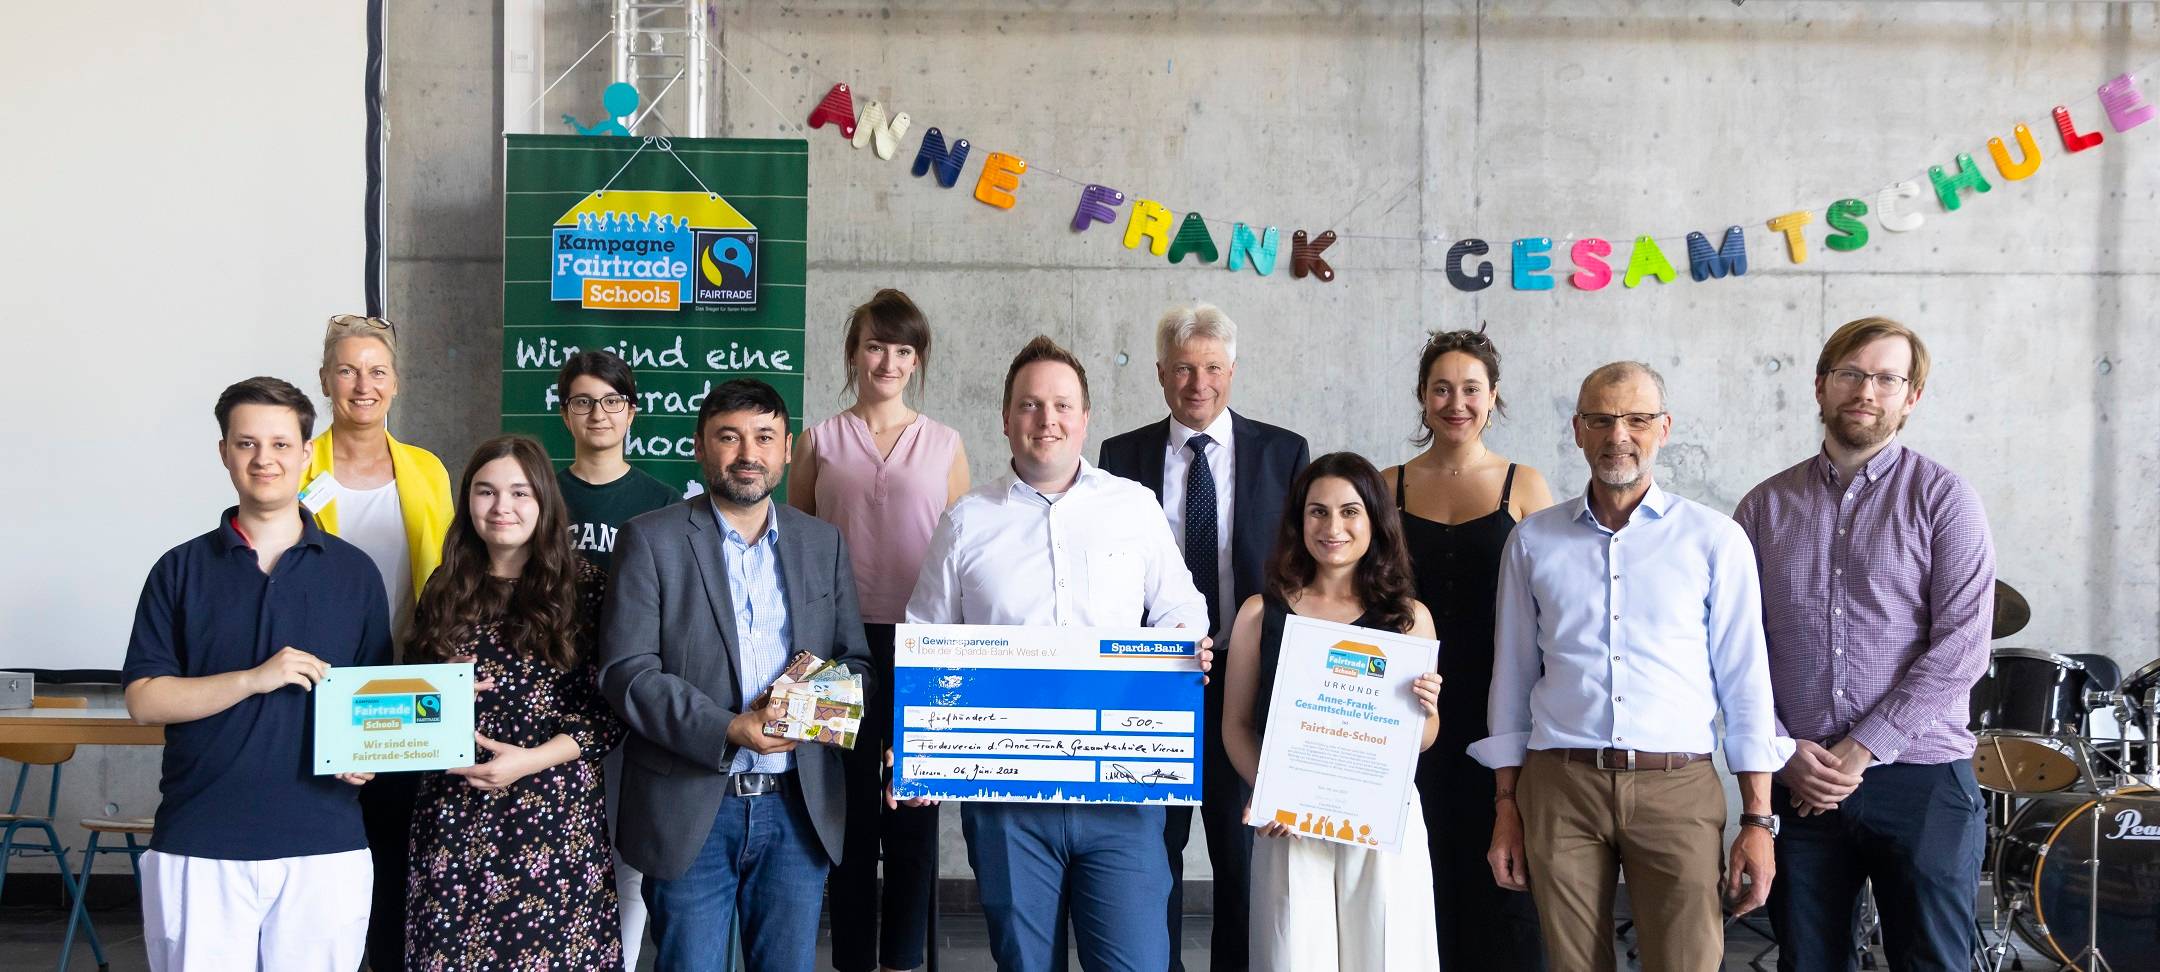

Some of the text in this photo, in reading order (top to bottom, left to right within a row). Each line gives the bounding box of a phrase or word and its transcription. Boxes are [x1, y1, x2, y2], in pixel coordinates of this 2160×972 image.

[807, 71, 2156, 292] ANNE FRANK GESAMTSCHULE
[558, 234, 676, 256] Kampagne
[557, 254, 688, 278] Fairtrade
[590, 284, 671, 304] Schools
[700, 290, 752, 299] FAIRTRADE
[516, 336, 580, 368] Wir
[706, 342, 793, 371] eine
[1016, 648, 1039, 657] West
[1111, 642, 1184, 654] Sparda-Bank
[1324, 680, 1380, 696] URKUNDE
[355, 703, 411, 716] Fairtrade
[1317, 693, 1376, 711] Anne-Frank-
[1295, 699, 1400, 726] Gesamtschule Viersen
[366, 720, 400, 729] Schools
[1300, 721, 1387, 745] Fairtrade-School
[364, 738, 429, 749] Wir sind eine
[352, 749, 440, 761] Fairtrade-School!
